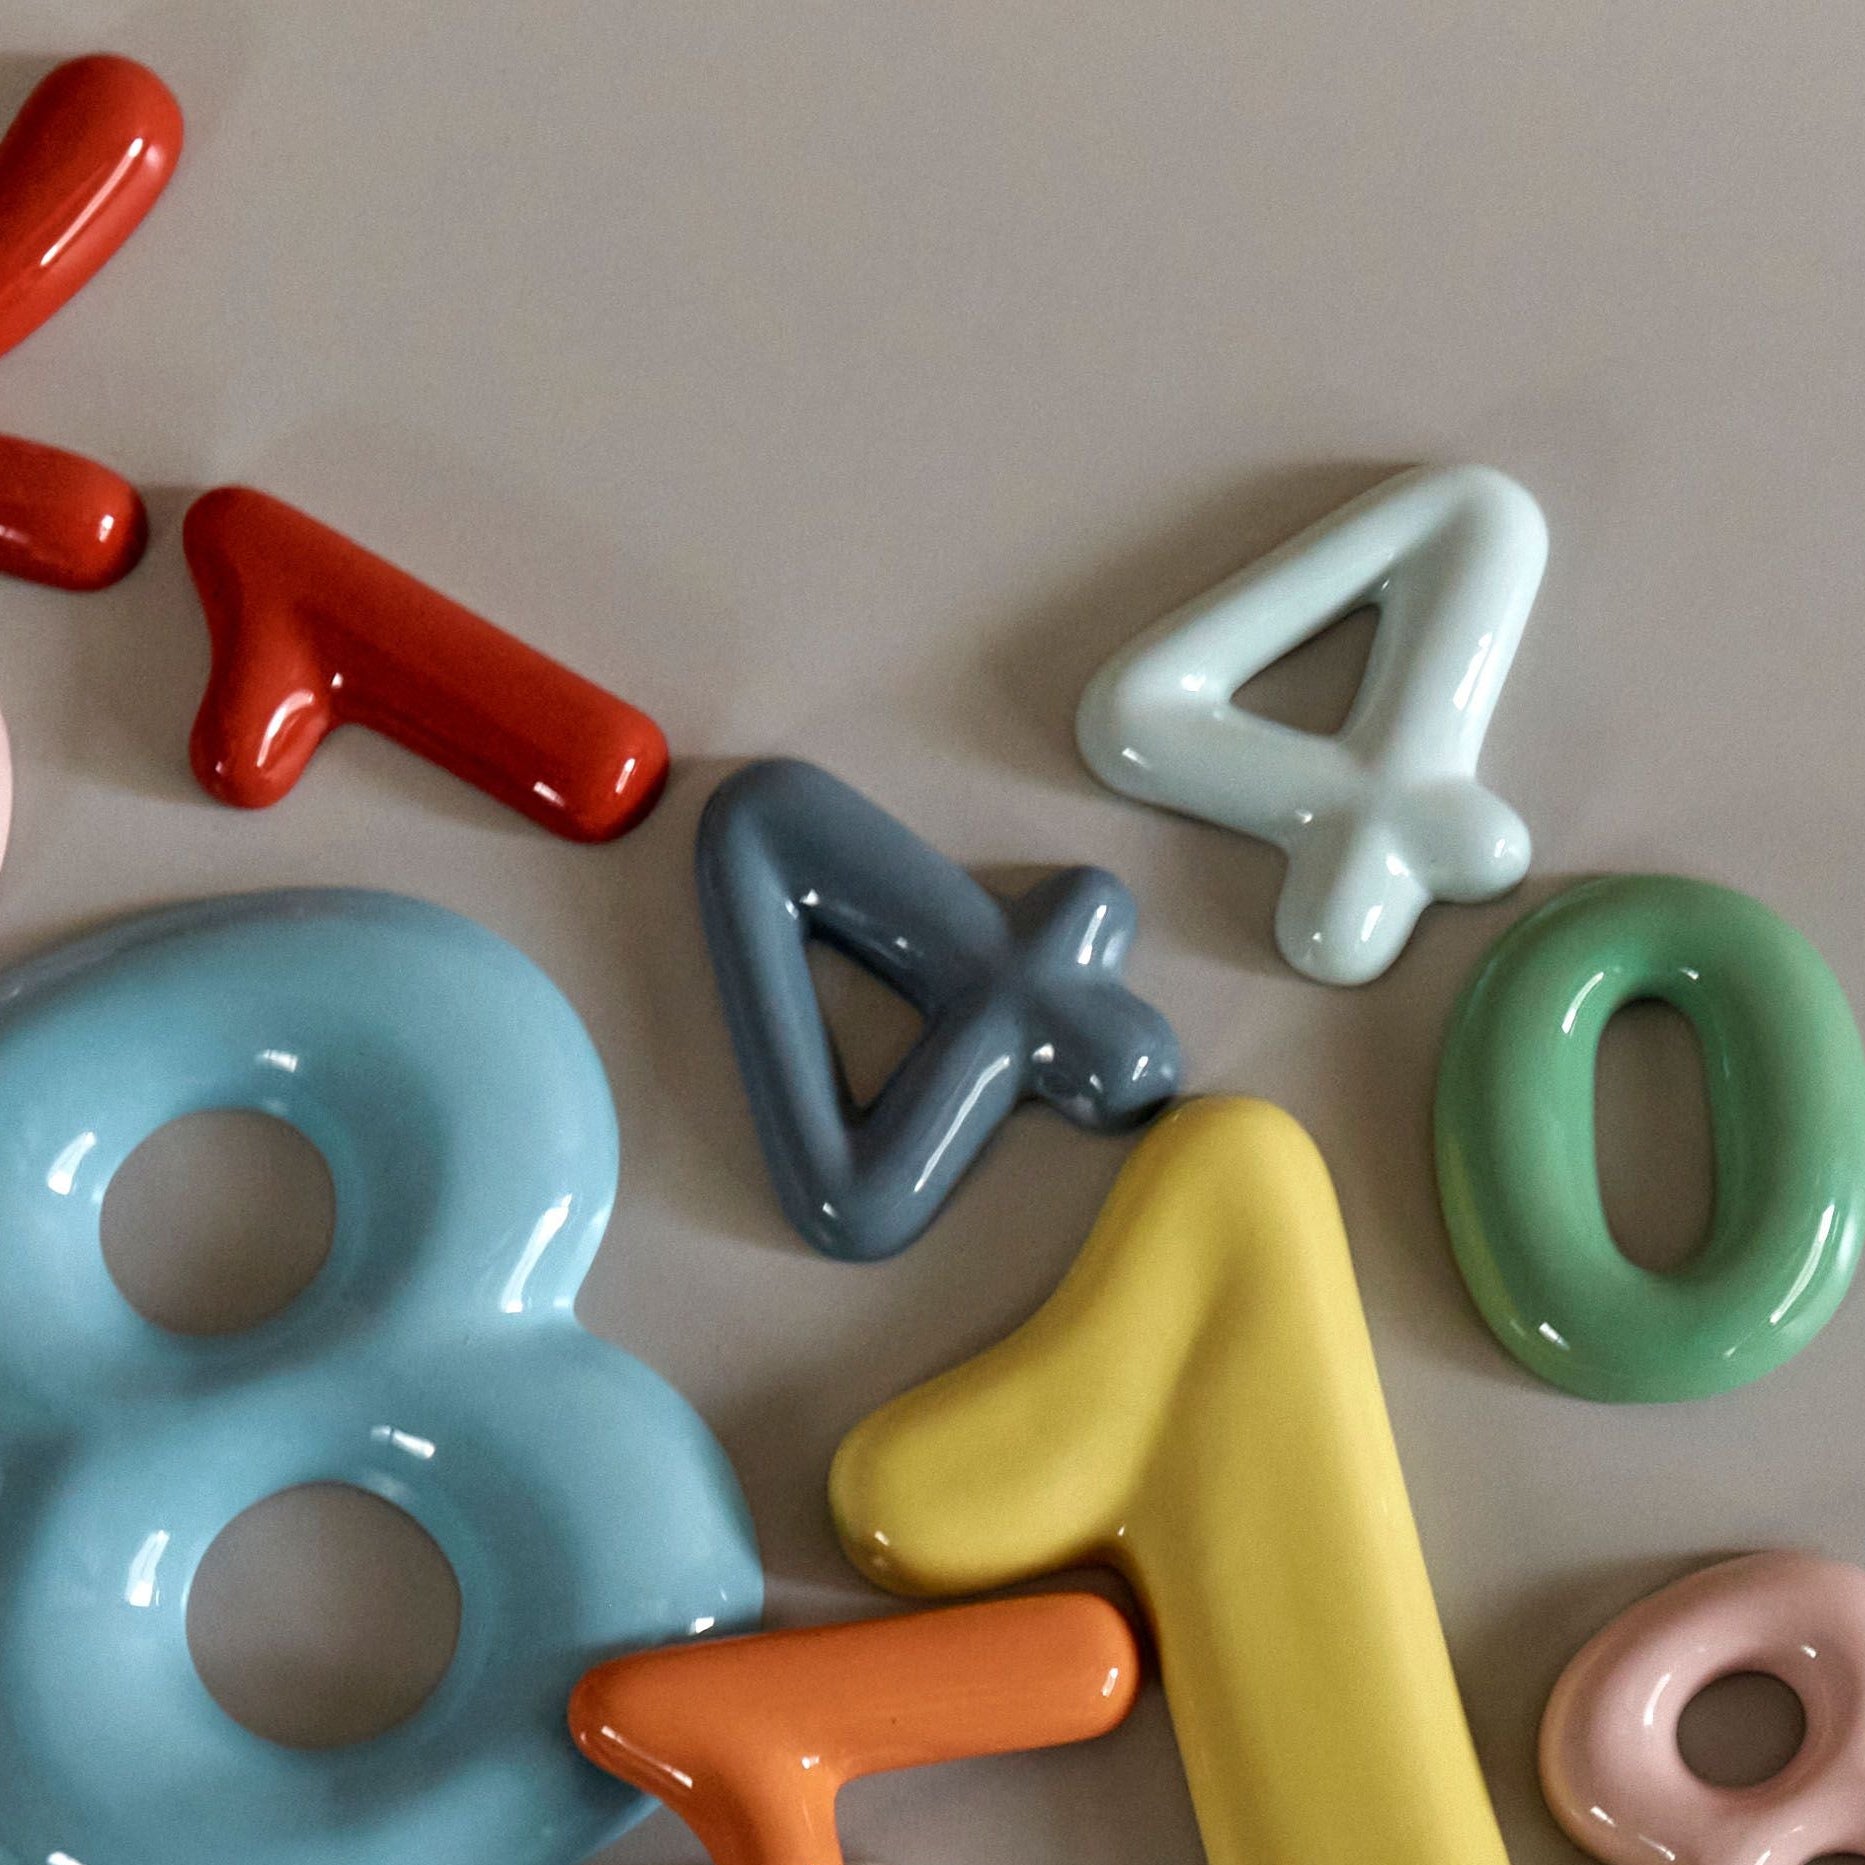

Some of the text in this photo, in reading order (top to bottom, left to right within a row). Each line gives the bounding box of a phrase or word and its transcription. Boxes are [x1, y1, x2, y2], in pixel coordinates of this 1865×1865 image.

[183, 484, 670, 843] 1
[1075, 463, 1550, 986] 4
[694, 757, 1187, 1262] 4
